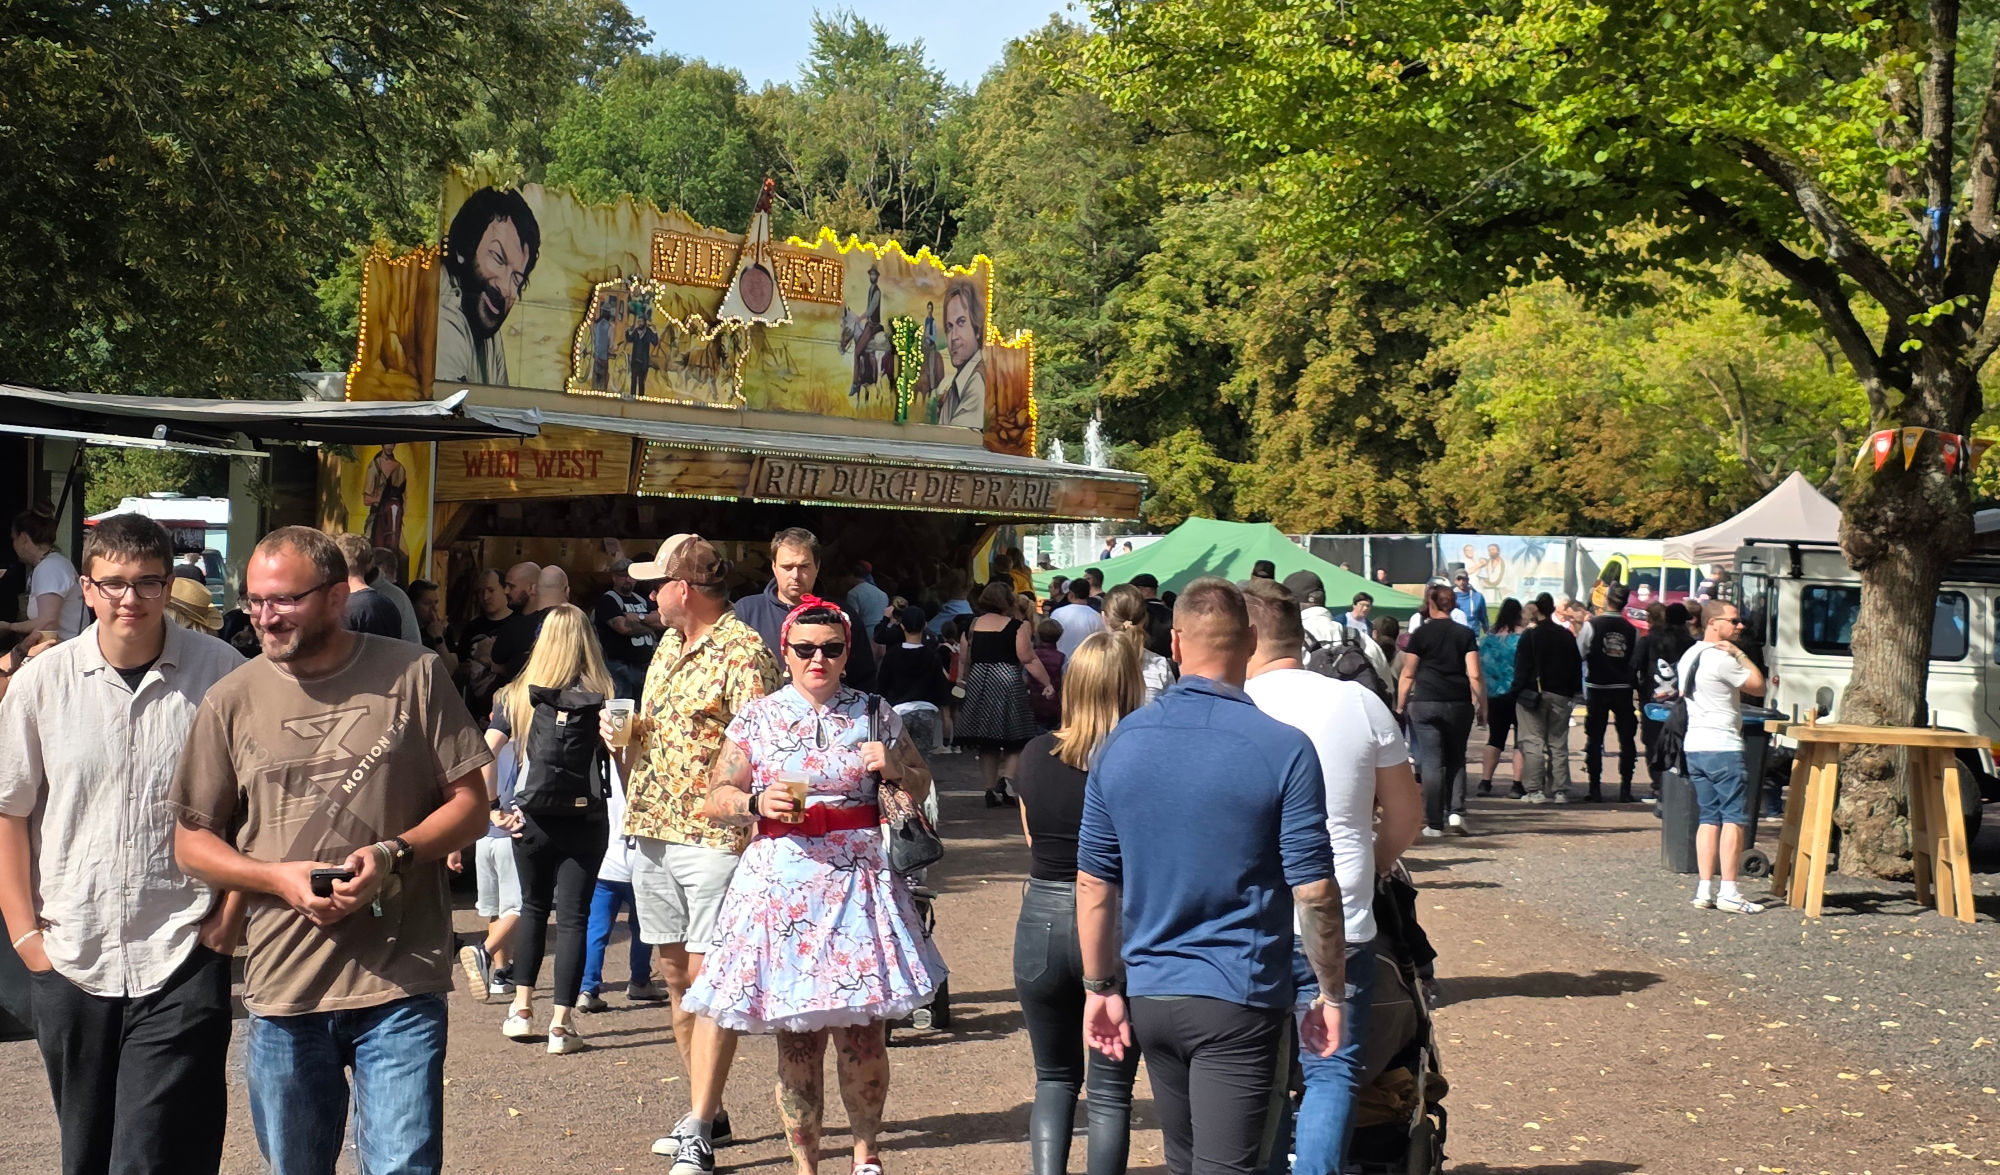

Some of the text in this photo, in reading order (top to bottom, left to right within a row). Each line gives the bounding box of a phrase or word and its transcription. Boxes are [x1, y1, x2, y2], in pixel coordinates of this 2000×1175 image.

[463, 449, 604, 480] WILD WEST
[766, 462, 826, 496] RITT
[830, 465, 917, 502] DURCH
[922, 471, 969, 504] DIE
[341, 735, 391, 794] MOTION
